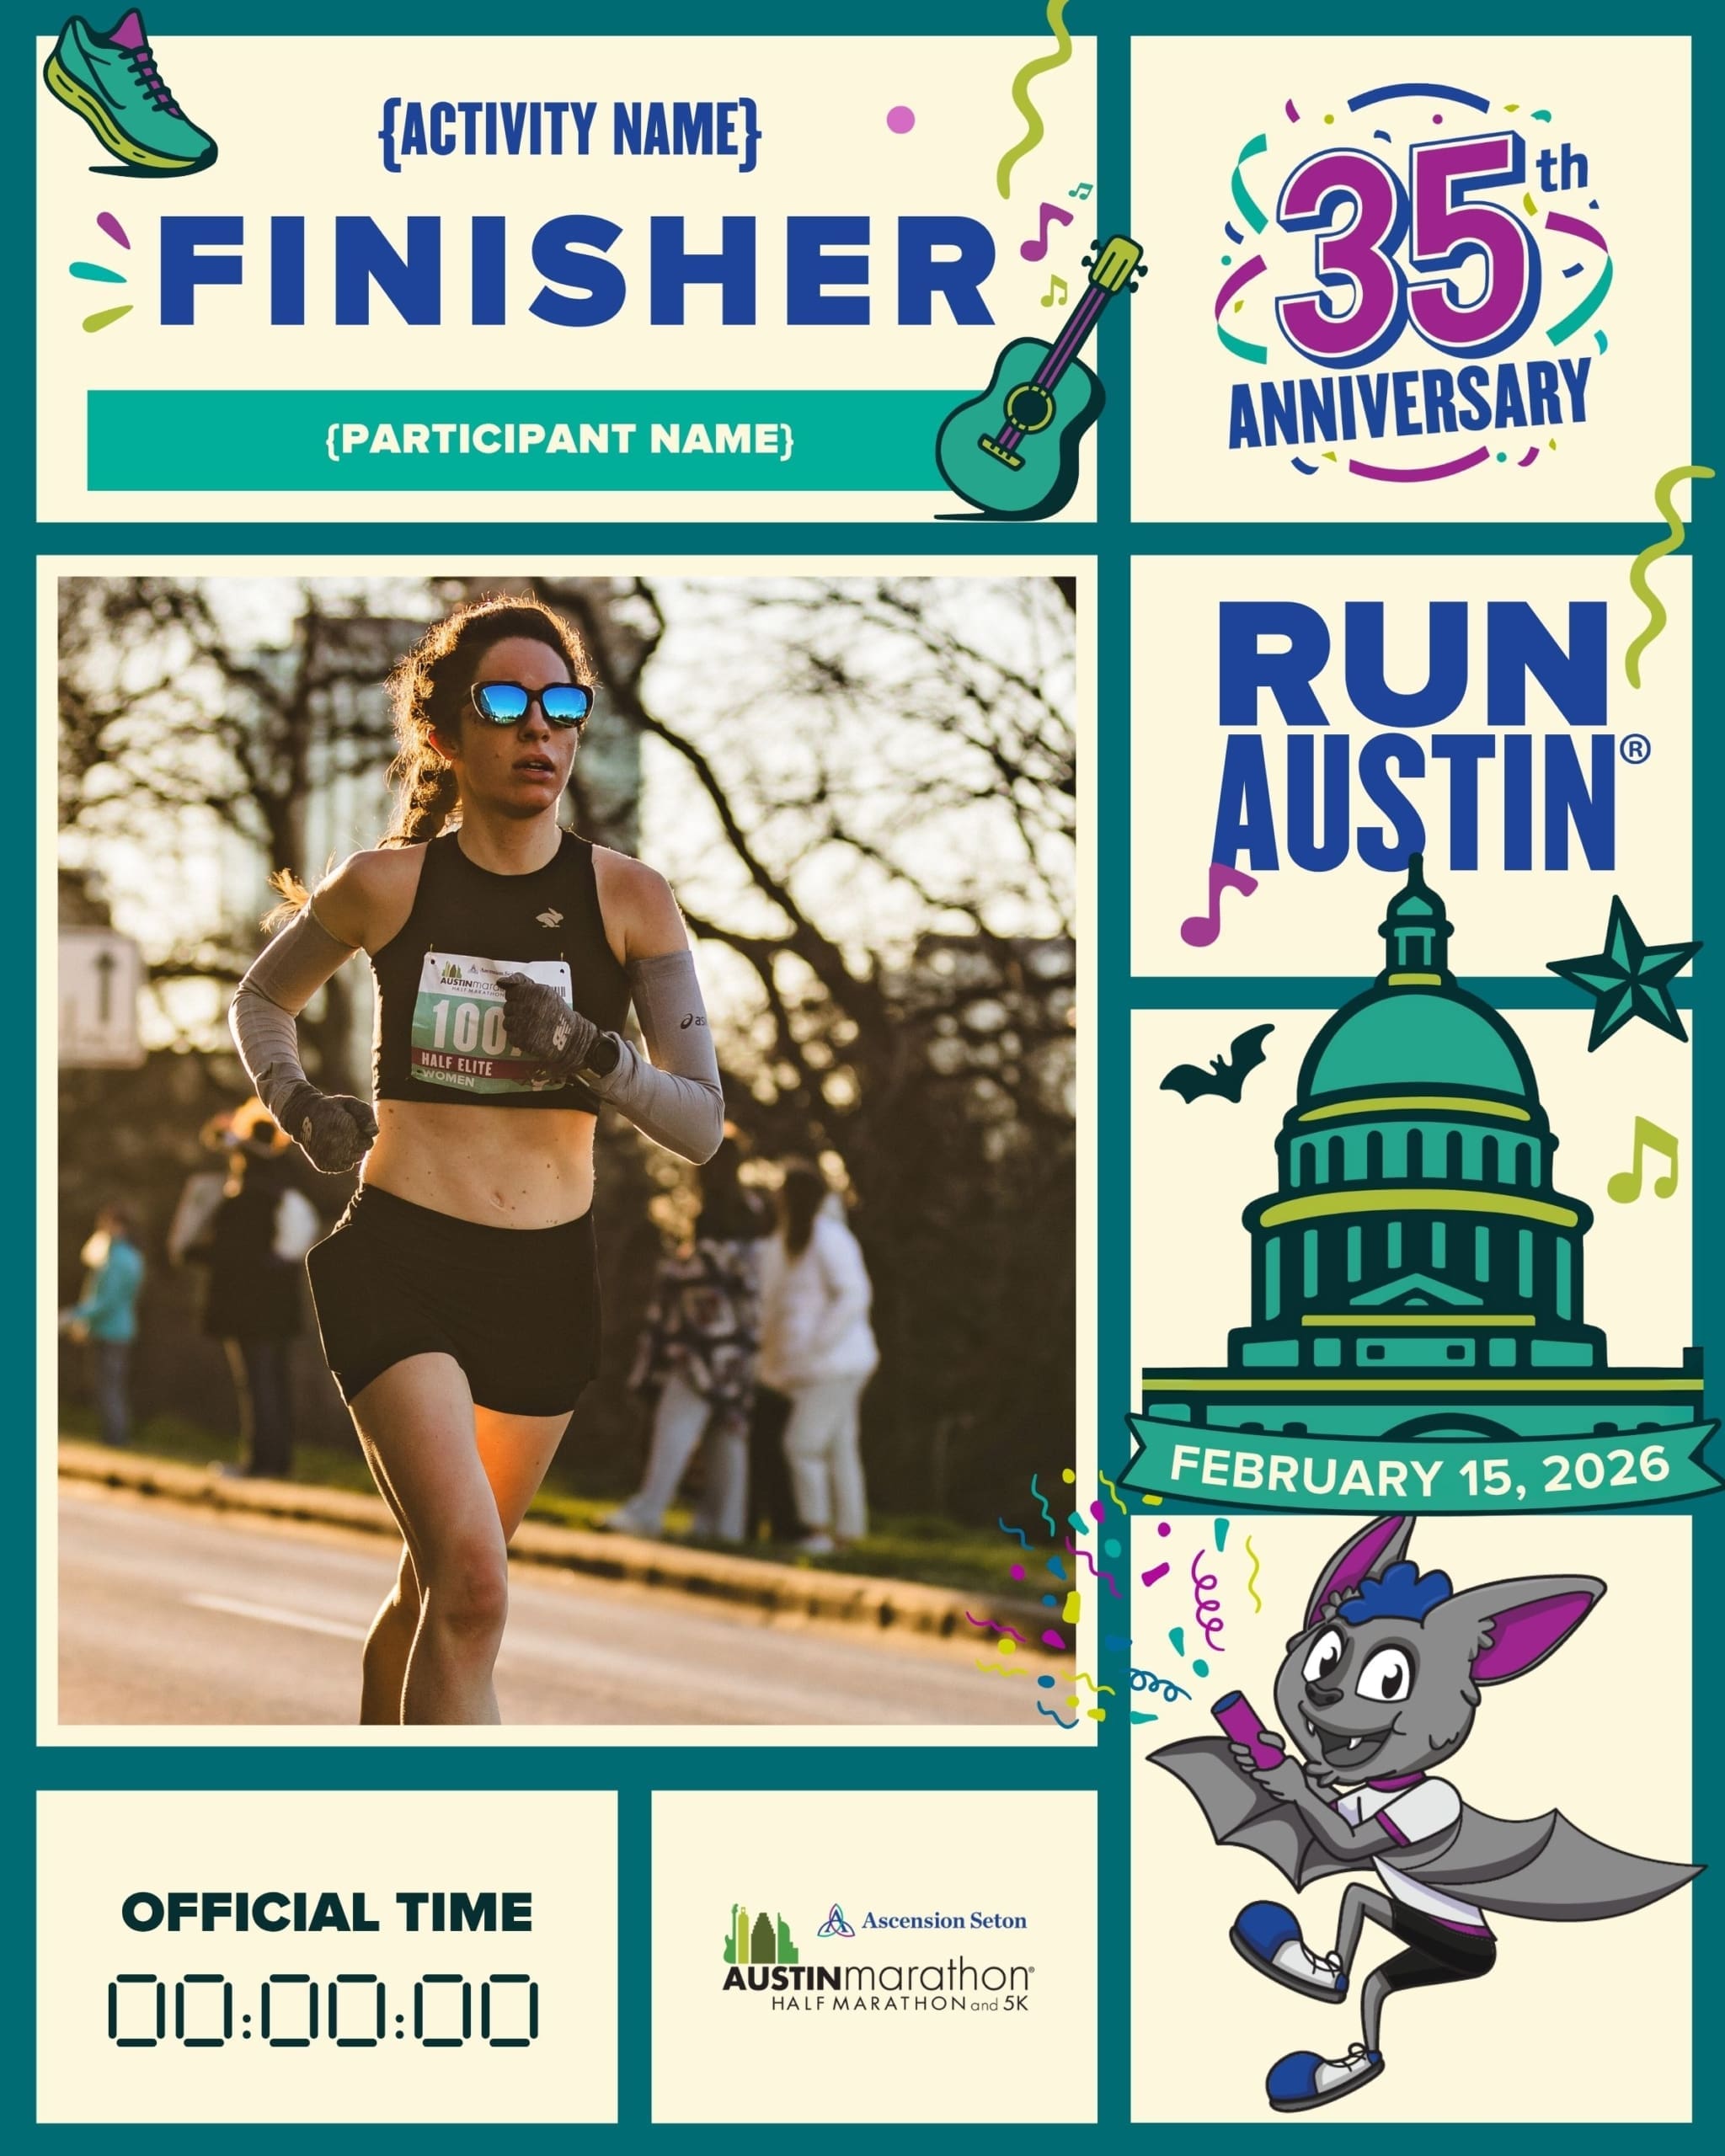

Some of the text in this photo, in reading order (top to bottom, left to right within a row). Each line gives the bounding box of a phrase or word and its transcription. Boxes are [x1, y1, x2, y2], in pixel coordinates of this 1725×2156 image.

[378, 97, 762, 173] {ACTIVITY NAME}
[160, 214, 996, 328] FINISHER
[1229, 357, 1591, 449] ANNIVERSARY
[326, 423, 793, 462] {PARTICIPANT NAME}
[1220, 601, 1607, 728] RUN
[433, 999, 523, 1057] 100
[421, 1052, 493, 1076] HALF ELITE
[422, 1069, 475, 1087] WOMEN
[1170, 1444, 1670, 1501] FEBRUARY 15, 2026
[122, 1892, 532, 1932] OFFICIAL TIME
[862, 1912, 1028, 1929] Ascension Seton
[108, 1974, 538, 2047] 00:00:00
[772, 1995, 1028, 2011] HALF MARATHON and 5K
